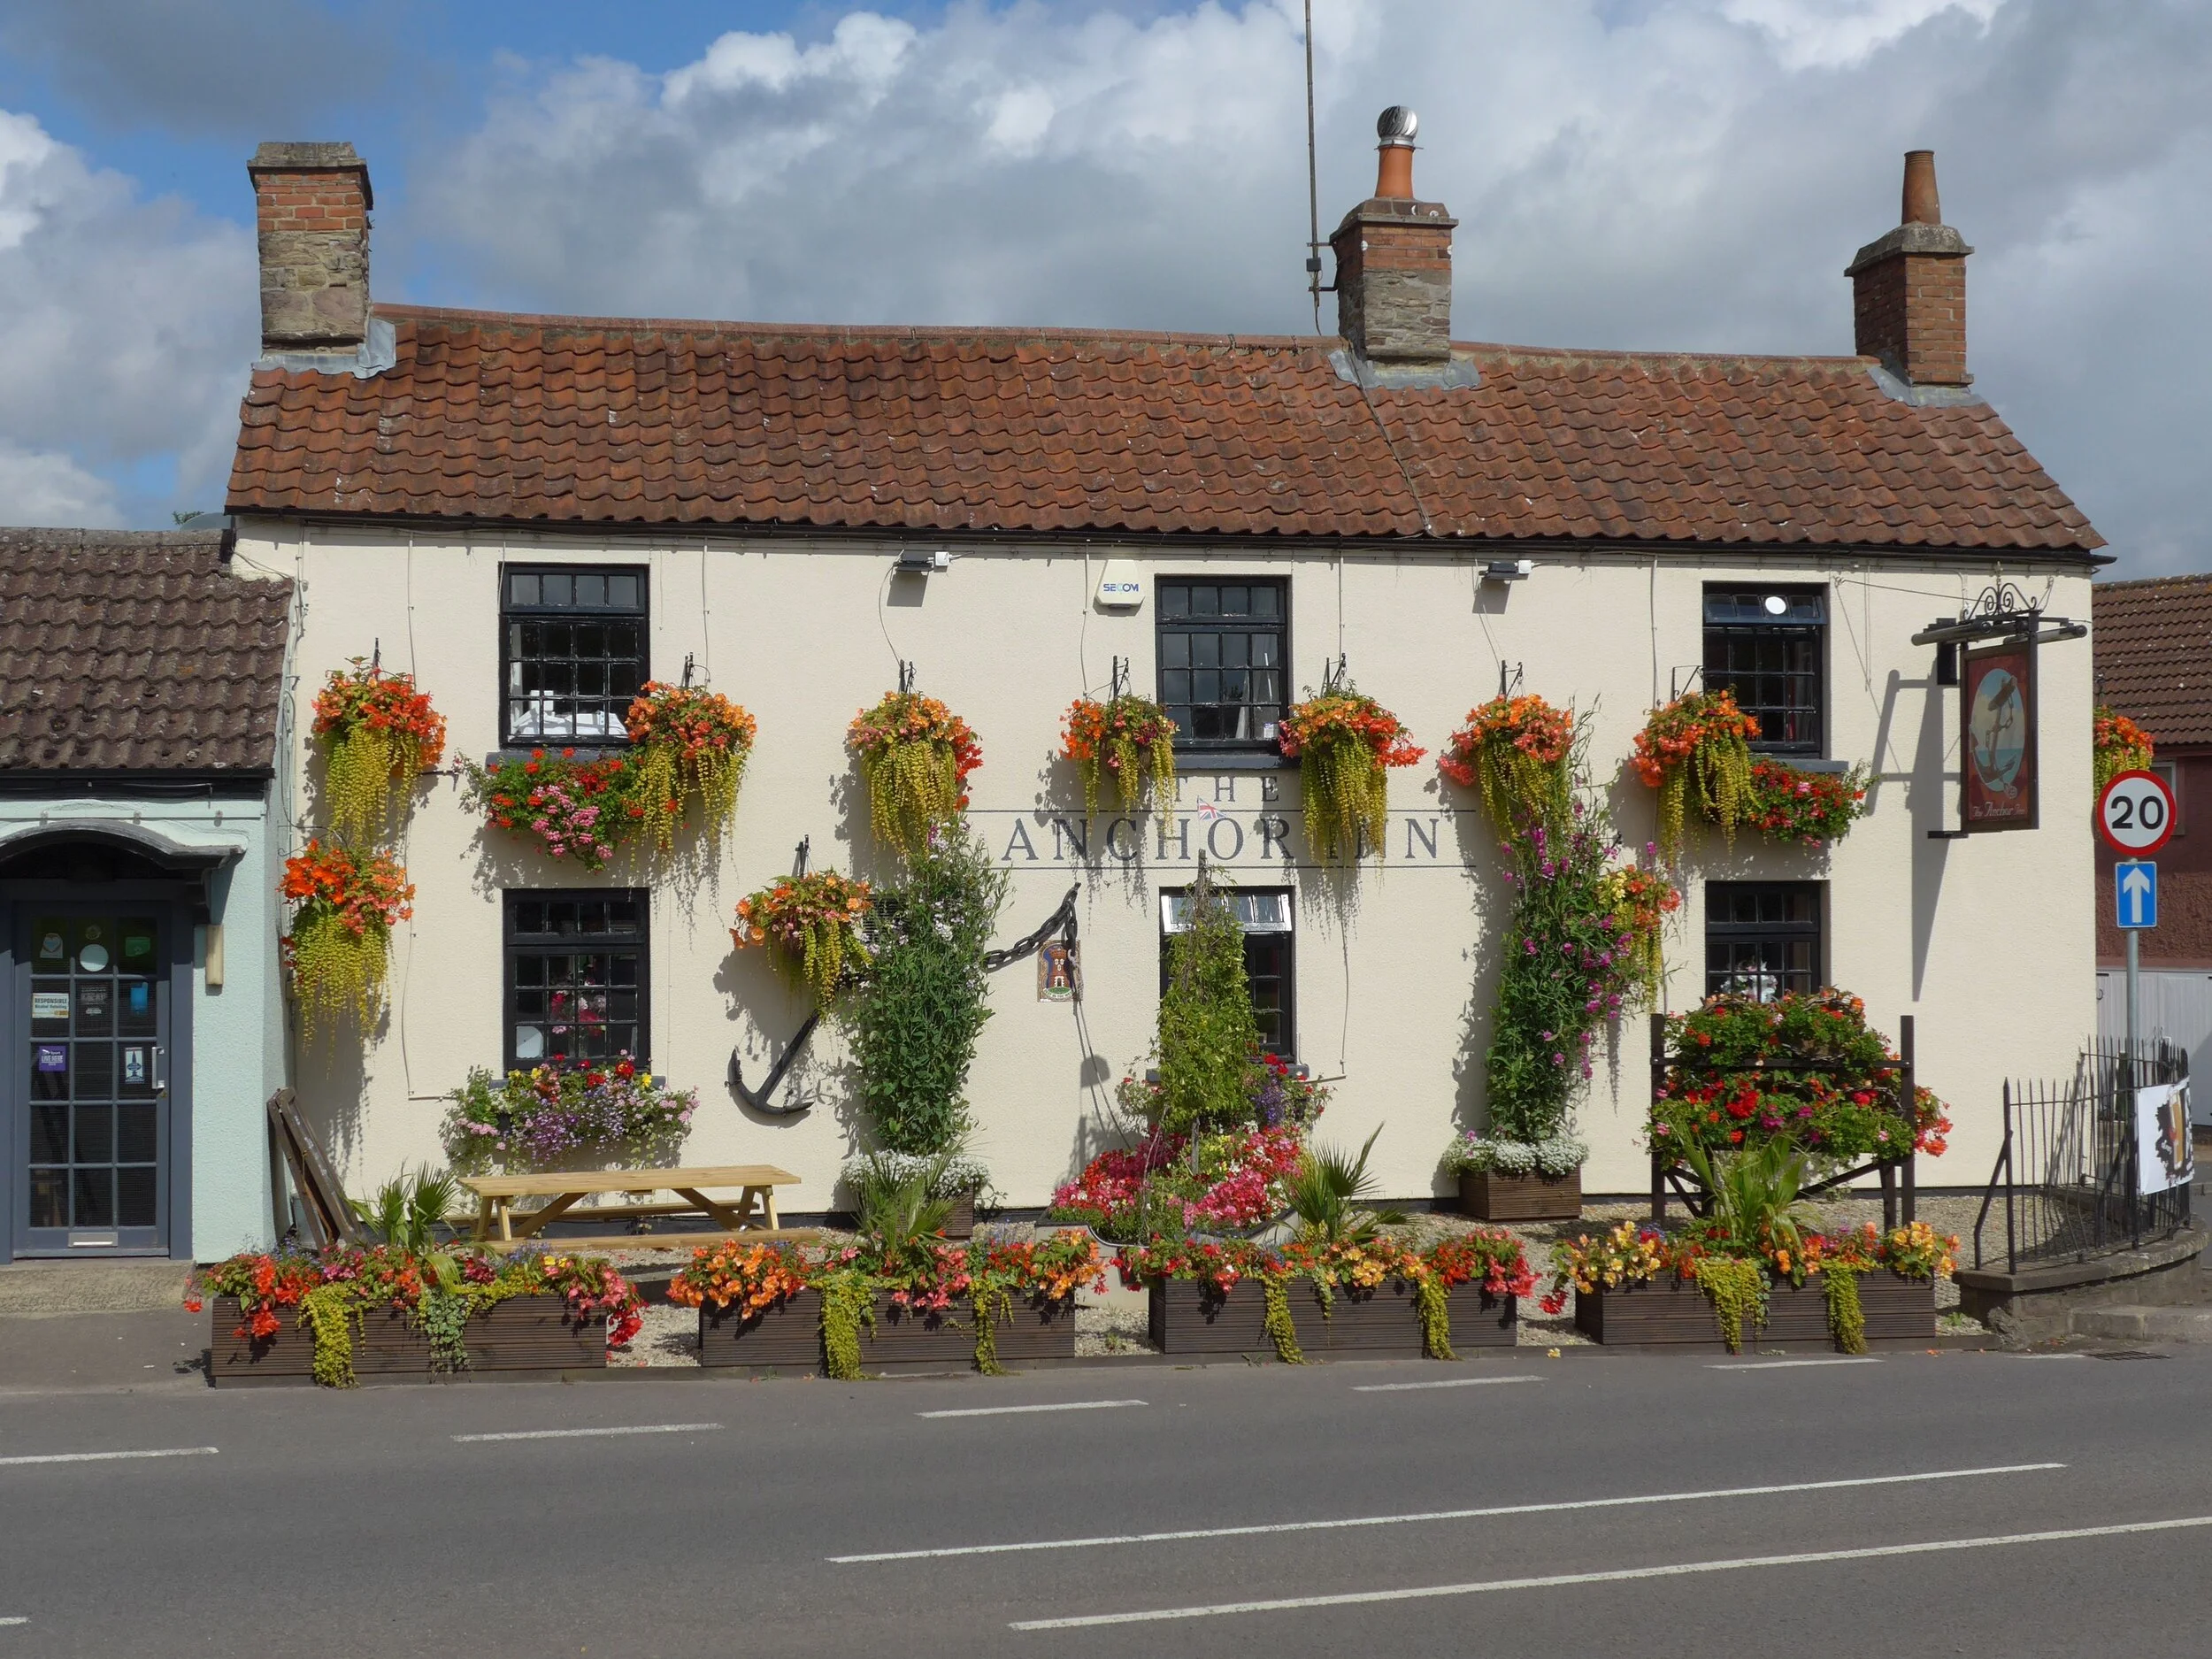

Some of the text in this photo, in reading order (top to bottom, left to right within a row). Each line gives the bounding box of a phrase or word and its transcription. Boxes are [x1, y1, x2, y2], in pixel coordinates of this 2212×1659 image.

[1103, 583, 1139, 593] SECOM
[1170, 775, 1279, 803] THE
[1985, 802, 2014, 817] Anchor
[2111, 795, 2164, 830] 20
[1001, 817, 1294, 861] ANCHOR
